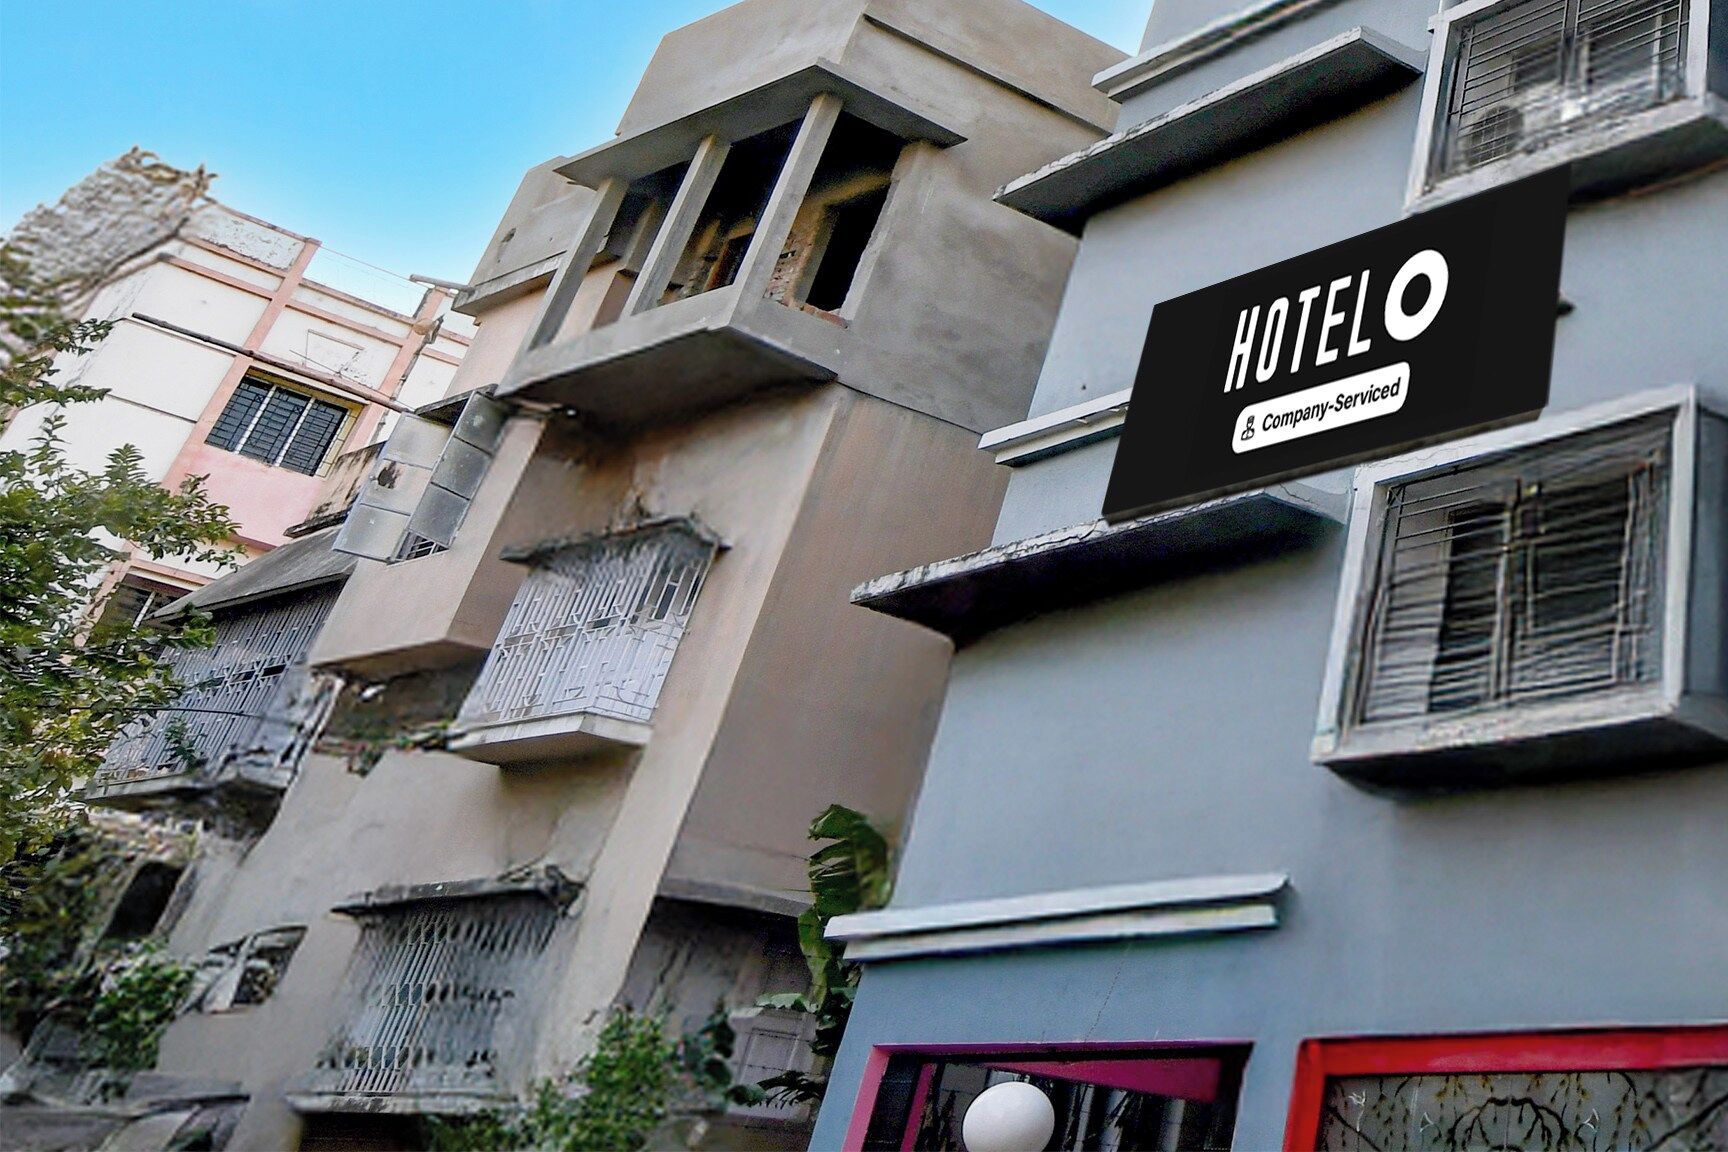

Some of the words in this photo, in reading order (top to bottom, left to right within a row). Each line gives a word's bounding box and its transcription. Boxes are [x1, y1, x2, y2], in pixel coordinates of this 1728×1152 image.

[1223, 269, 1372, 393] HOTEL
[1384, 249, 1449, 341] O
[1262, 377, 1402, 432] Company-Serviced
